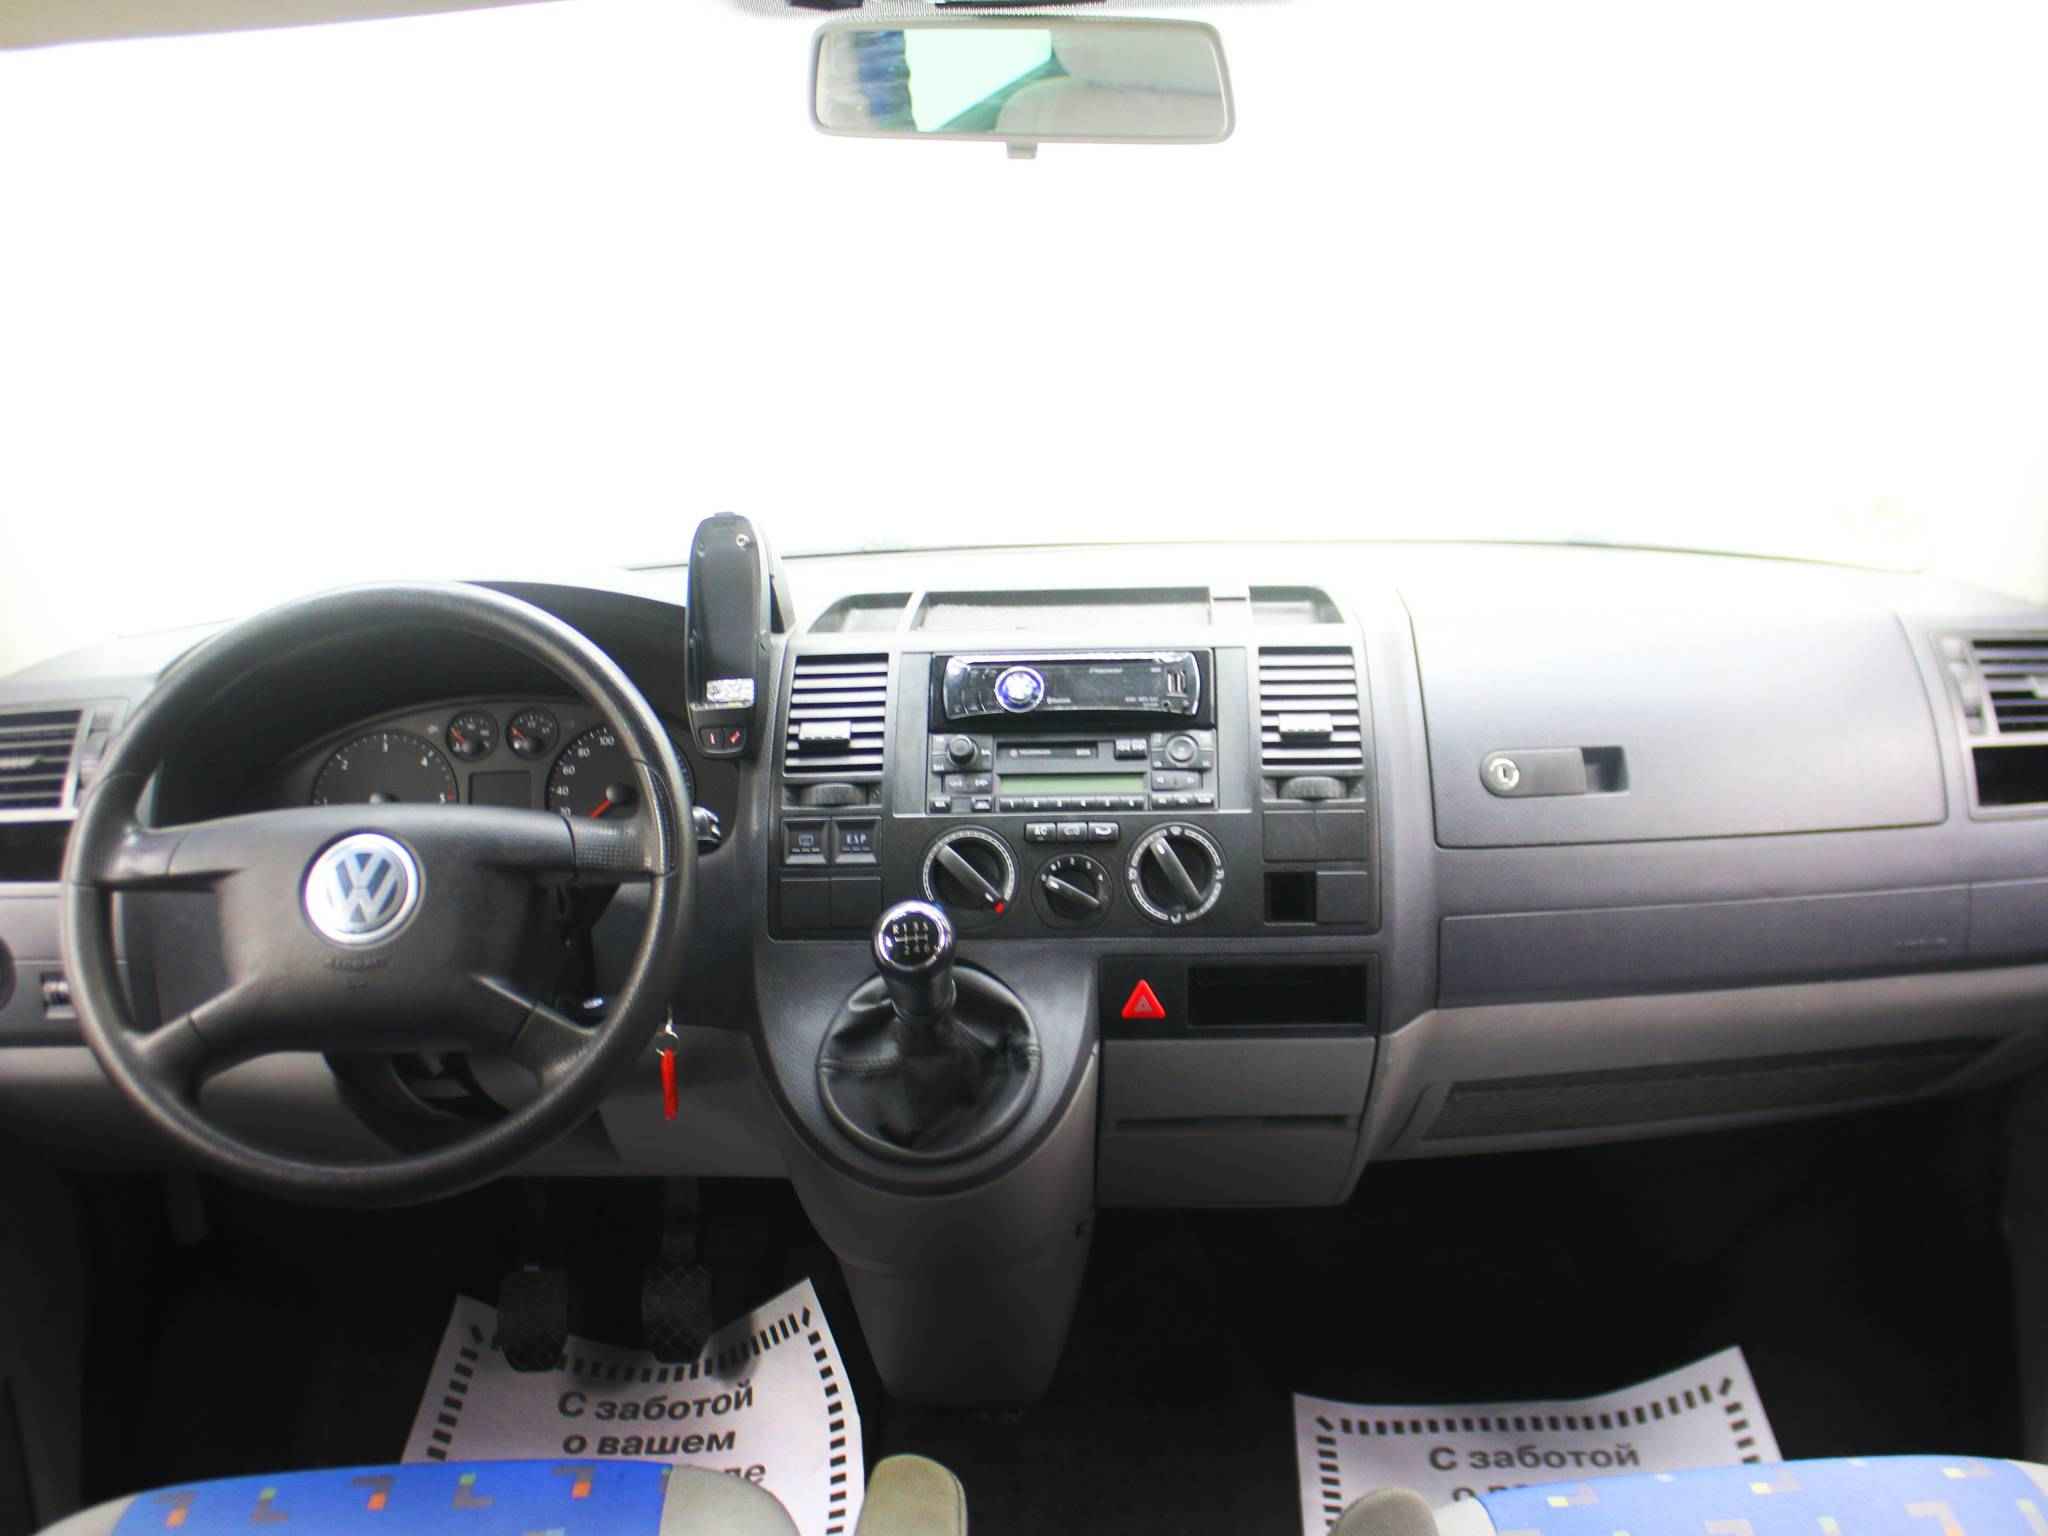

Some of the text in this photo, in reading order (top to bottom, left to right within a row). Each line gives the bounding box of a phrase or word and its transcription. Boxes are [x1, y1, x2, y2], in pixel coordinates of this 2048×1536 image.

[600, 736, 615, 747] 100
[577, 747, 590, 758] 80
[562, 765, 576, 776] 60
[556, 785, 569, 796] 40
[557, 1379, 754, 1420] С заботой
[562, 1429, 737, 1456] о вашем
[1428, 1443, 1641, 1471] С заботой
